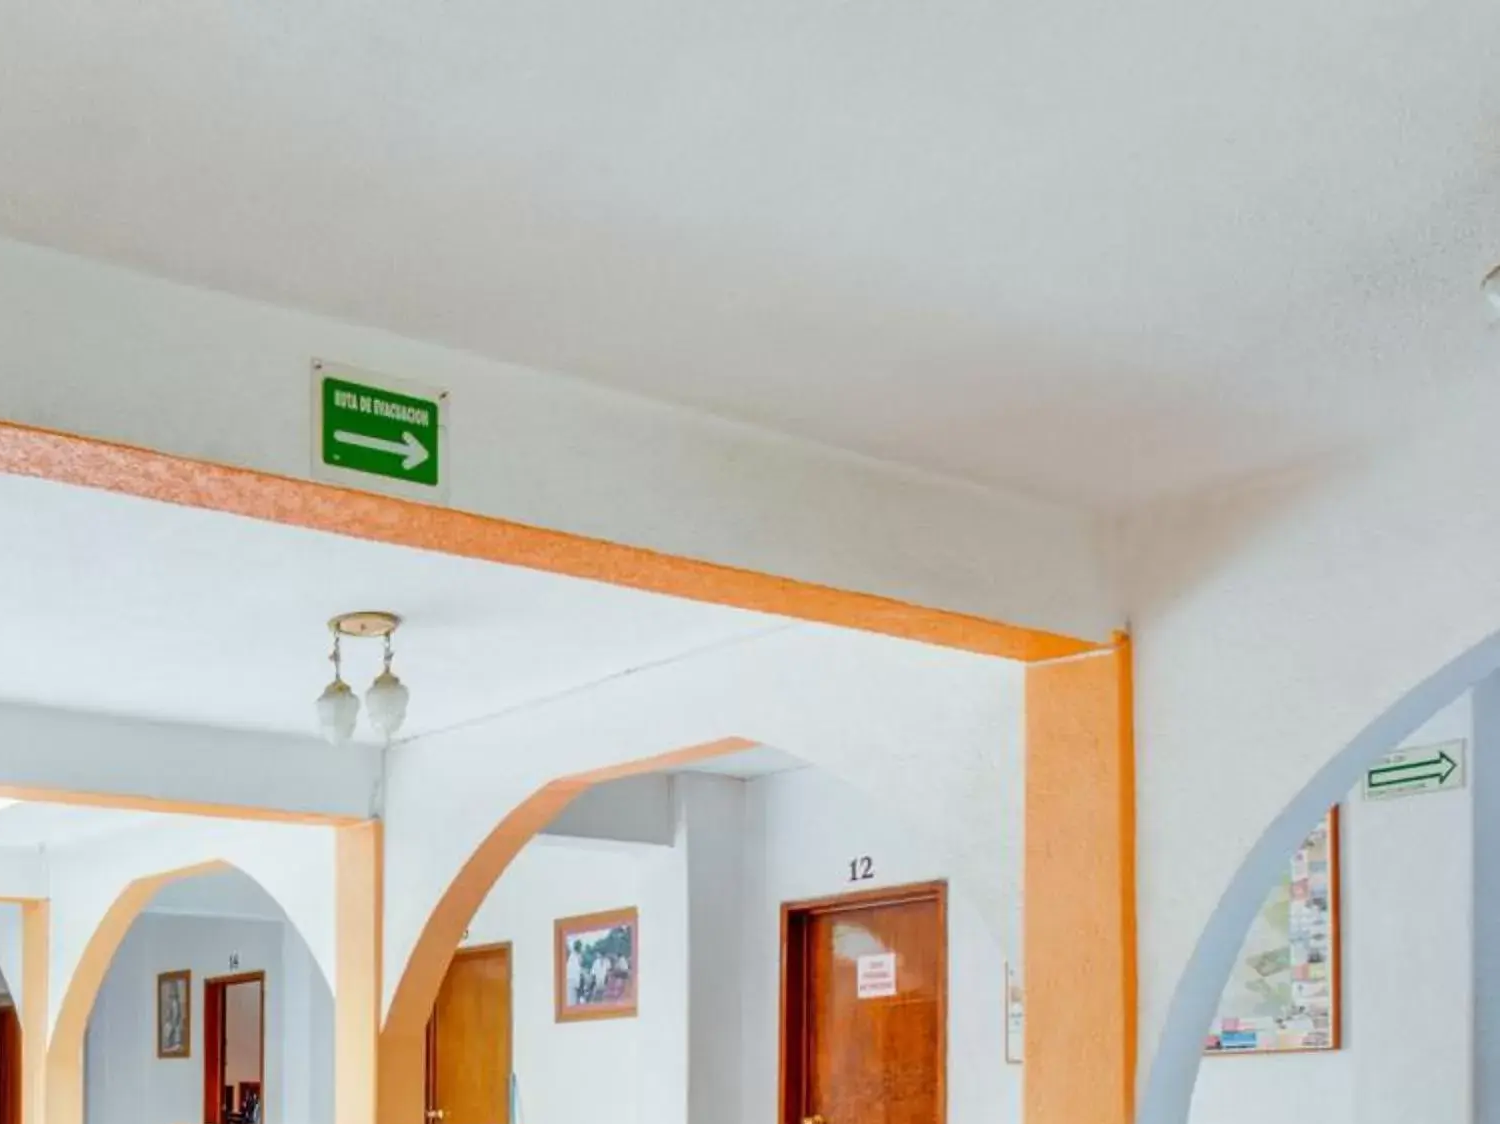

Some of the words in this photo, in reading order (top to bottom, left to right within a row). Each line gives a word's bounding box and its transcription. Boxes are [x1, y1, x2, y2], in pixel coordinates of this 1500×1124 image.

[334, 389, 357, 411] RUTA
[360, 395, 372, 414] DE
[849, 855, 874, 881] 12
